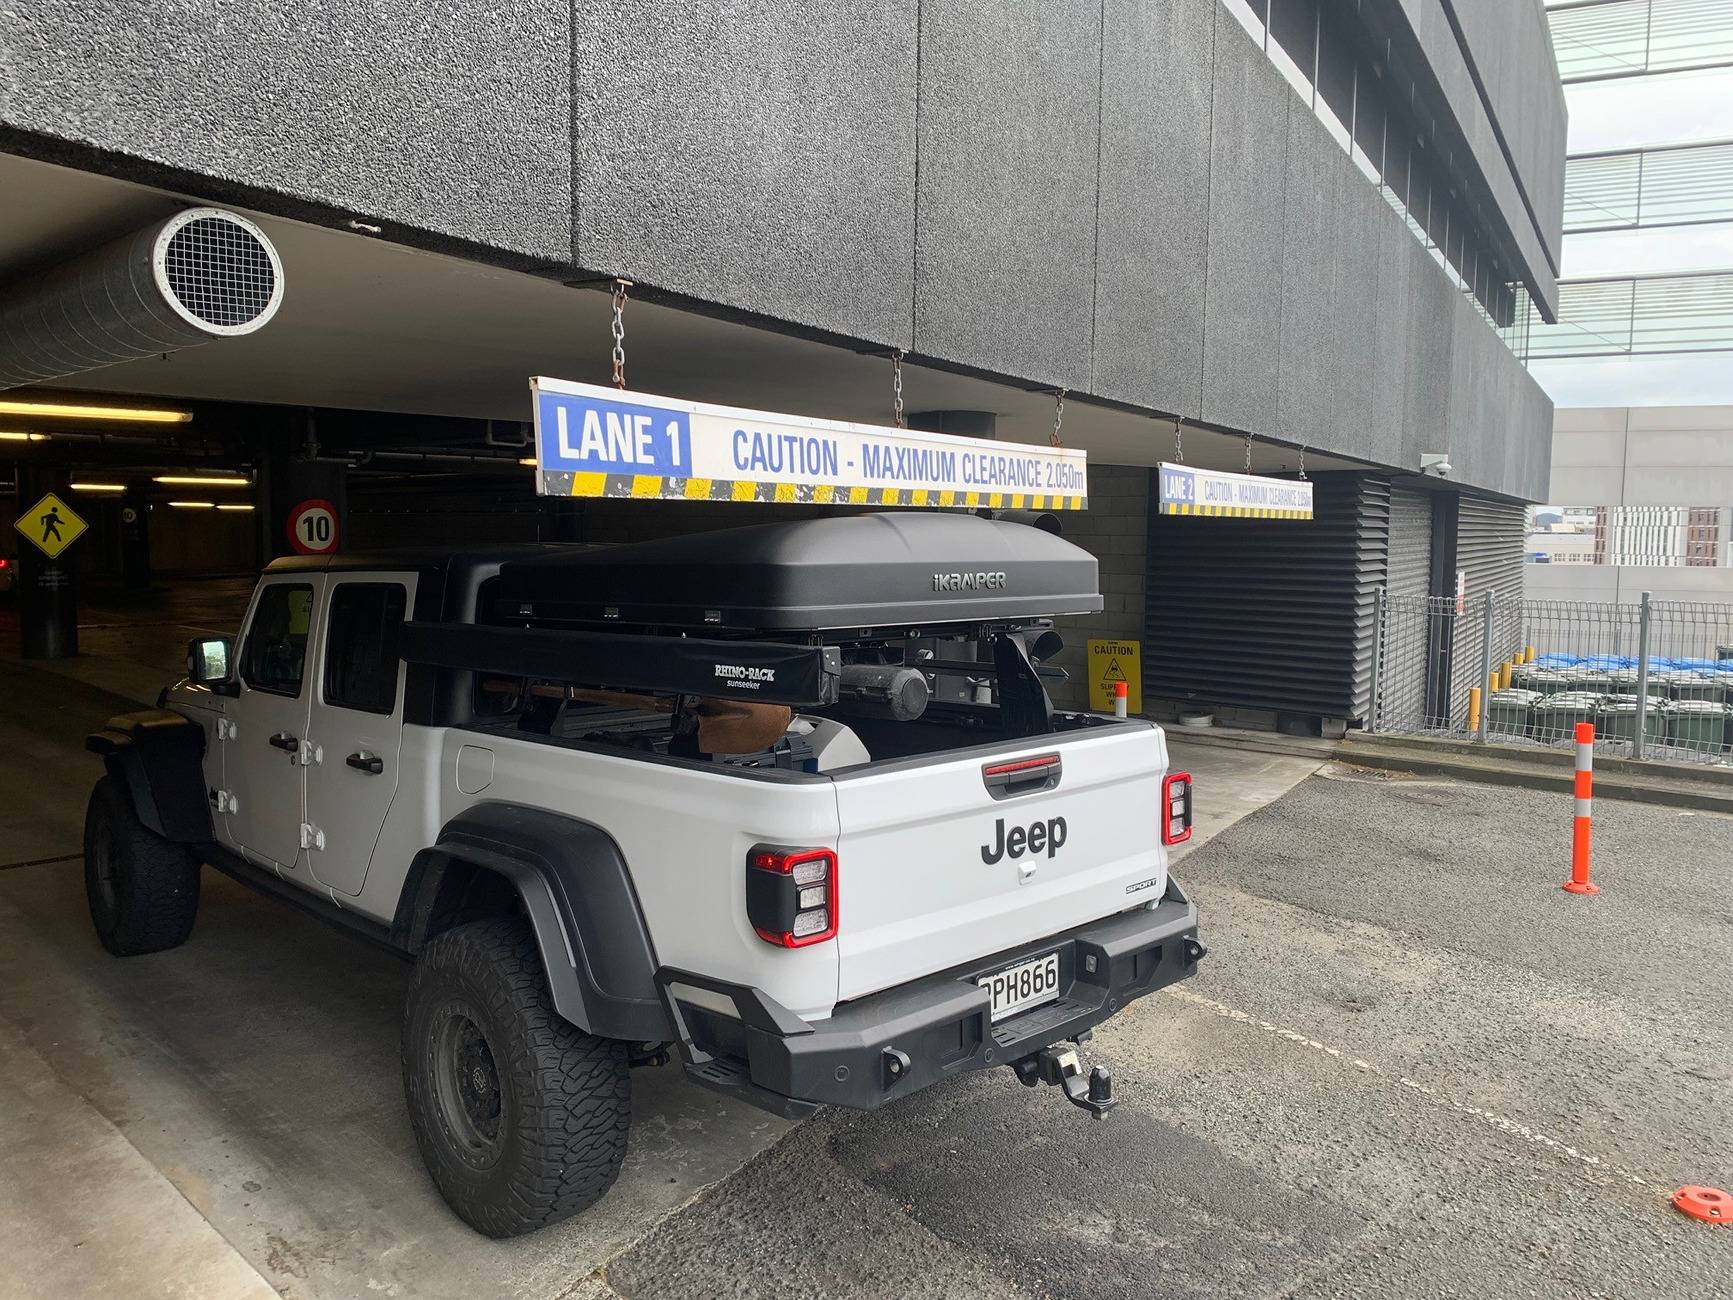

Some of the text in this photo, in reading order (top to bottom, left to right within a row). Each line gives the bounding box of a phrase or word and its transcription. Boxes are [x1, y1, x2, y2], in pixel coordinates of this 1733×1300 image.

[556, 406, 681, 466] LANE 1
[732, 429, 838, 476] CAUTION
[862, 443, 956, 483] MAXIMUM
[962, 452, 1042, 487] CLEARANCE
[1046, 462, 1084, 490] 2.050m
[1164, 475, 1194, 500] LANE 2
[1204, 480, 1232, 502] CAUTION
[1239, 484, 1268, 505] MAXIMUM
[303, 516, 330, 542] 10
[1094, 646, 1133, 655] CAUTION
[715, 664, 775, 681] RHINO-RACK
[727, 680, 760, 689] sunseeker
[981, 816, 1068, 865] Jeep
[1126, 878, 1157, 894] SPORT
